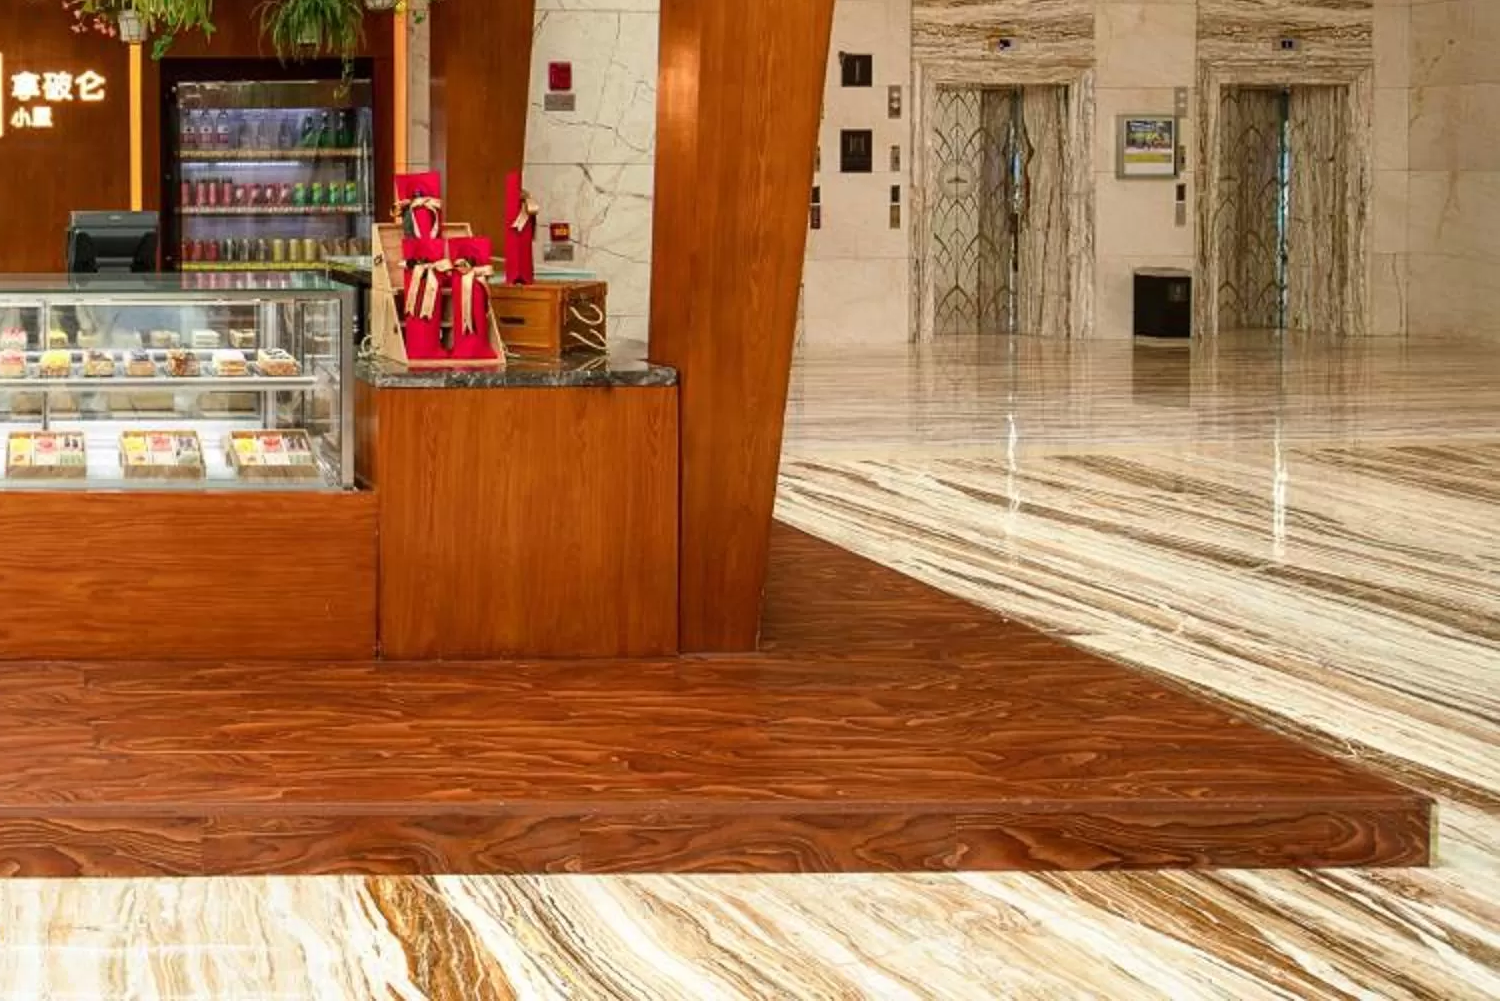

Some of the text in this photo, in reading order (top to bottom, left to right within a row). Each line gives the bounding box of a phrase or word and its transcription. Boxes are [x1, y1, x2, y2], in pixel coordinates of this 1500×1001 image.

[10, 69, 106, 102] 拿破仑
[10, 105, 53, 129] 小屋
